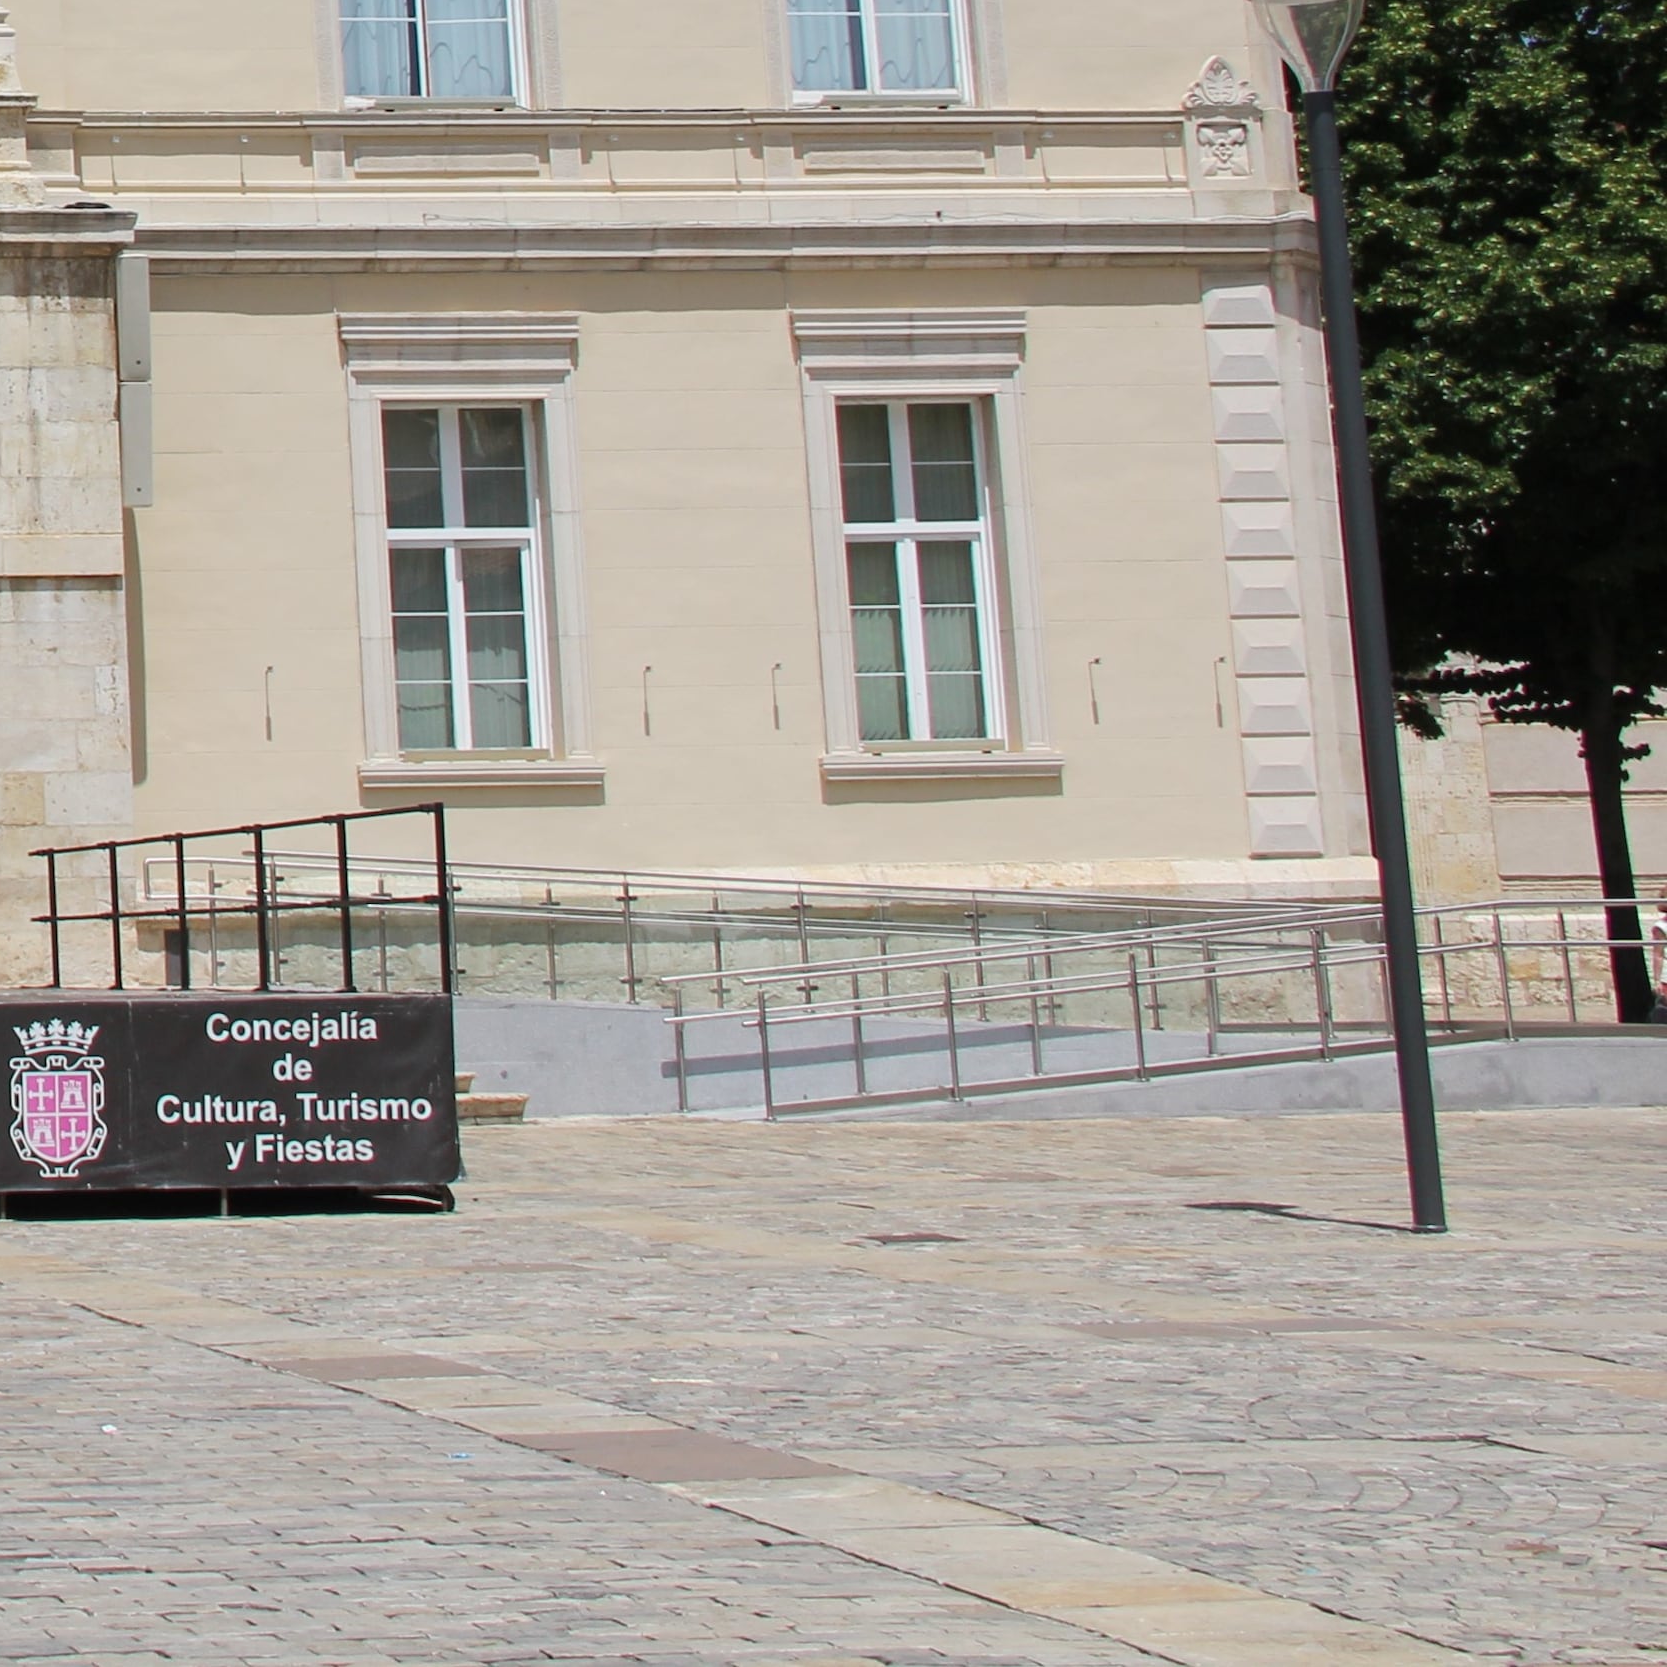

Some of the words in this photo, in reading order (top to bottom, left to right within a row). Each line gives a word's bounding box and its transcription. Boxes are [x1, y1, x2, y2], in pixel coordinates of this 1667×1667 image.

[206, 1011, 378, 1046] Concejalía
[273, 1052, 313, 1082] de
[157, 1094, 286, 1127] Cultura,
[296, 1092, 433, 1121] Turismo
[225, 1141, 245, 1171] y
[255, 1133, 374, 1163] Fiestas
